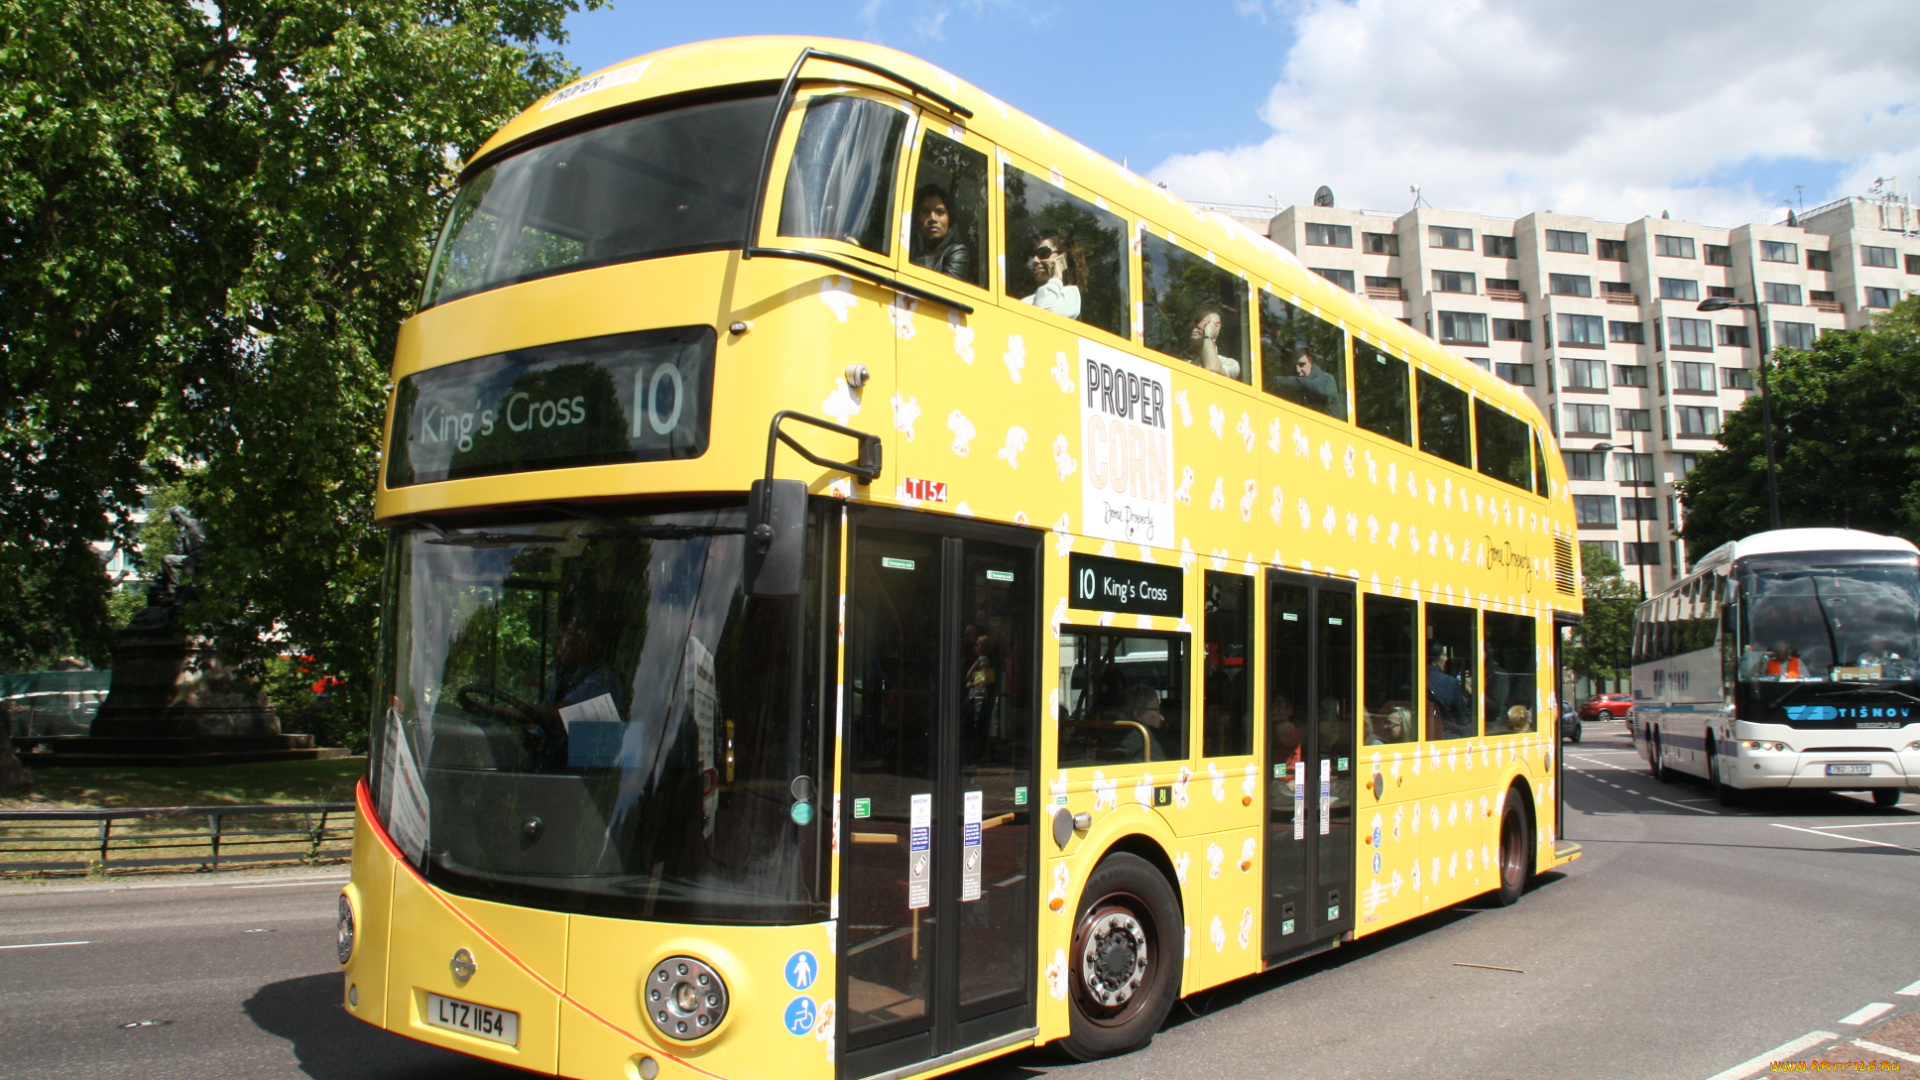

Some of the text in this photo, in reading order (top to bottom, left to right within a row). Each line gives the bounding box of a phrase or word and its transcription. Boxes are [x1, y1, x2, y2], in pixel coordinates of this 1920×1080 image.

[420, 362, 683, 452] King's Cross 10
[1086, 358, 1166, 430] PROPER
[1087, 414, 1168, 504] CORN
[1079, 567, 1168, 604] 10 King's Cross
[1839, 706, 1911, 718] TIŠNOV
[440, 999, 503, 1037] LTZ 1154
